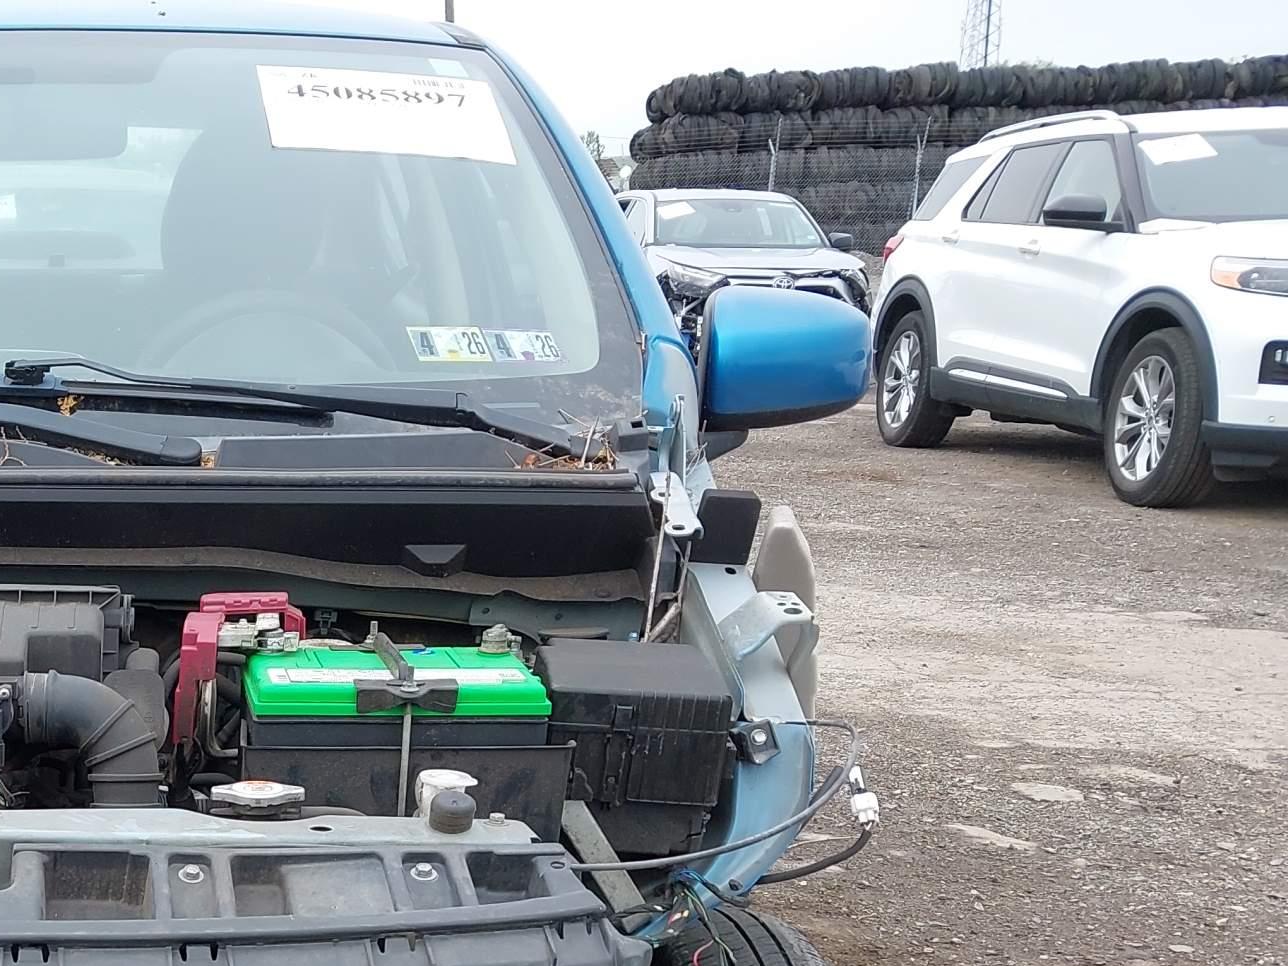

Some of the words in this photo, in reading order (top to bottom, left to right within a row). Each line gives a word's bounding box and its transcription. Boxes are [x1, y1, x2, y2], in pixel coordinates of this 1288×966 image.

[287, 83, 466, 108] 45085897
[419, 331, 436, 355] 4
[461, 331, 486, 355] 26
[495, 333, 513, 358] 4
[535, 334, 560, 358] 26
